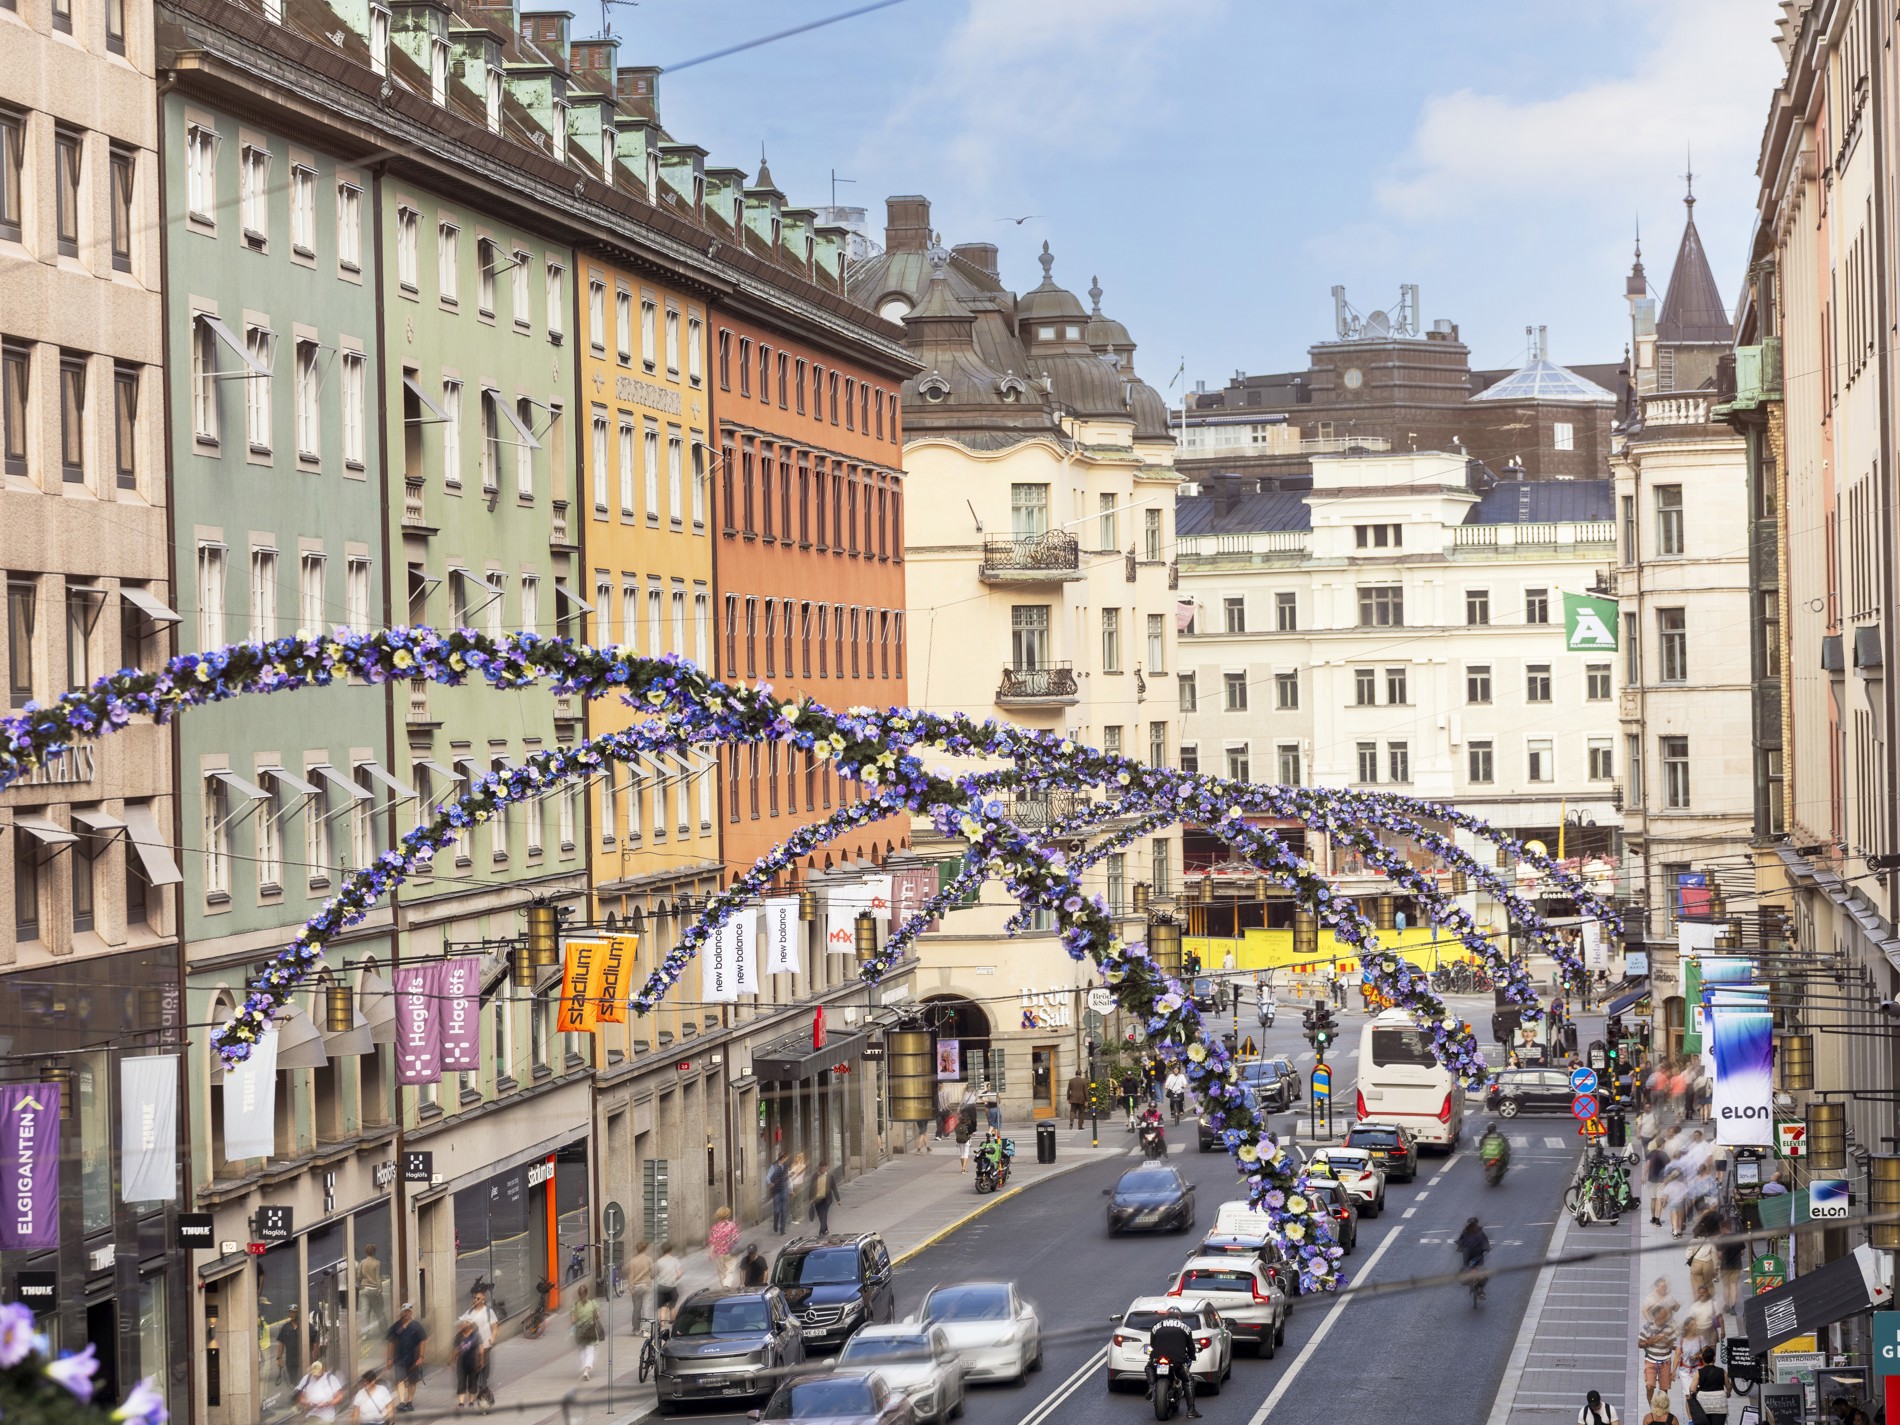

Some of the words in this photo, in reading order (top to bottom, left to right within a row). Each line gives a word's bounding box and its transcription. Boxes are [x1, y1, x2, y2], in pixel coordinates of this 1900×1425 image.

[871, 895, 888, 909] AX
[779, 908, 787, 943] balance
[829, 928, 853, 944] MAX
[715, 928, 723, 968] balance
[736, 922, 744, 961] balance
[569, 949, 592, 1025] stadium
[601, 937, 625, 1016] stadium
[736, 963, 744, 984] new
[449, 968, 468, 1035] Haglöfs
[1020, 985, 1068, 1008] Bröd
[1092, 992, 1112, 1000] Bröd
[409, 977, 428, 1047] Haglöfs
[17, 1113, 35, 1235] ELGIGANTEN
[181, 1226, 210, 1236] THULE
[262, 1228, 287, 1237] Haglöfs
[21, 1285, 53, 1296] THULE
